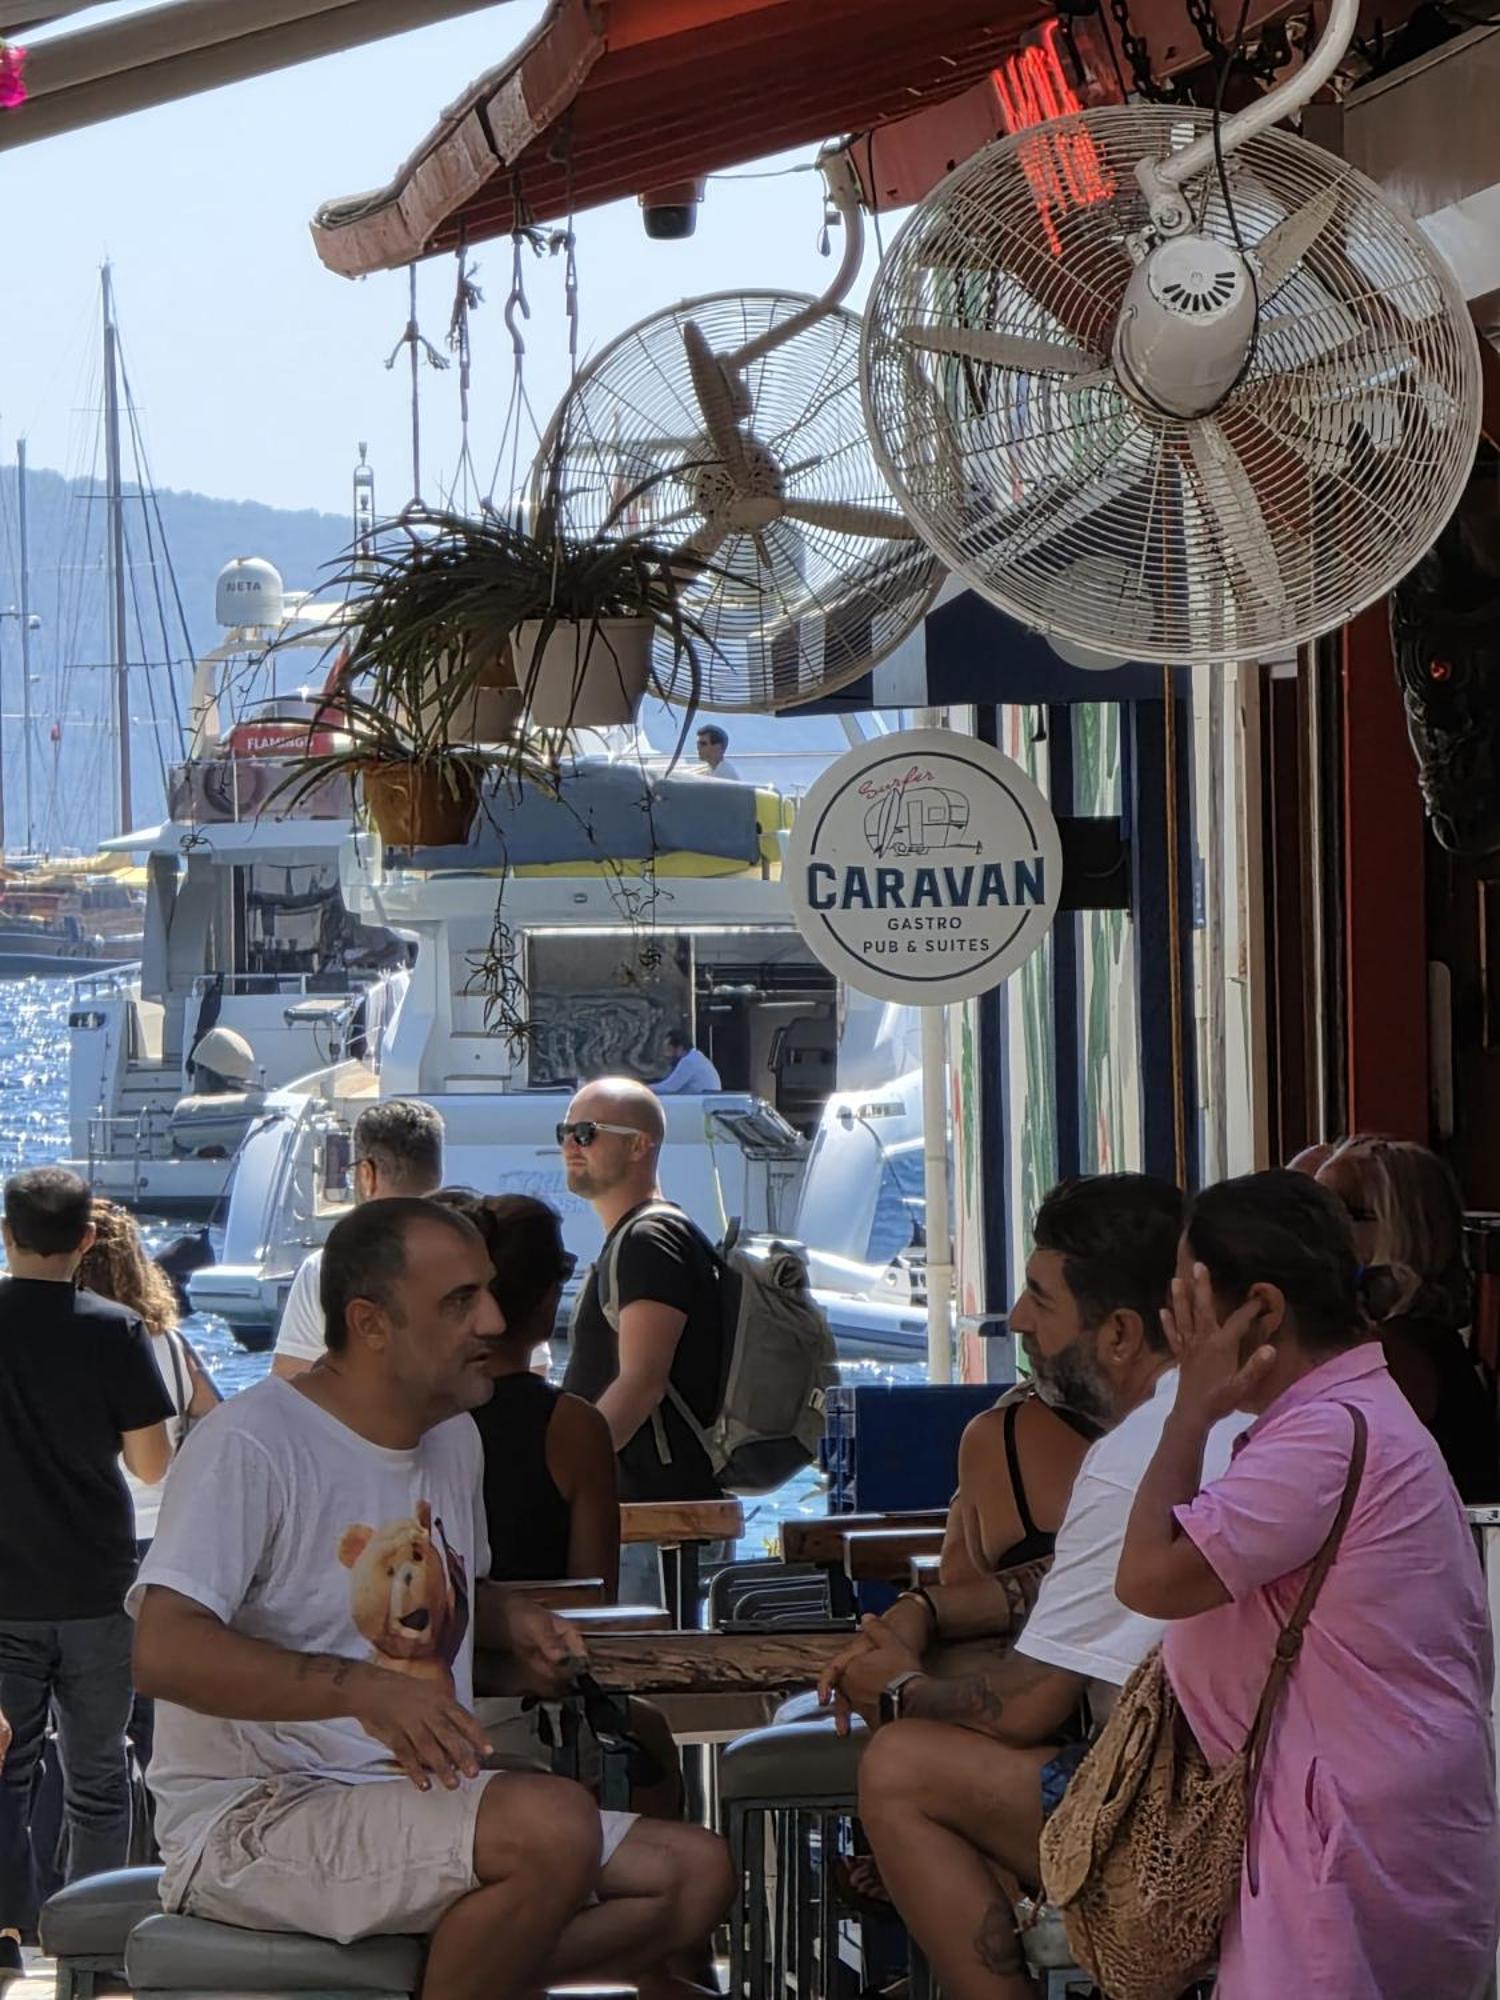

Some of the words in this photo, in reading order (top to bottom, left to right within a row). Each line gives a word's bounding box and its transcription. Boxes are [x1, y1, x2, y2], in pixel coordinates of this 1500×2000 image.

[807, 857, 1046, 910] CARAVAN
[887, 916, 962, 931] GASTRO
[863, 940, 898, 954] PUB
[907, 940, 917, 953] &
[926, 938, 989, 952] SUITES
